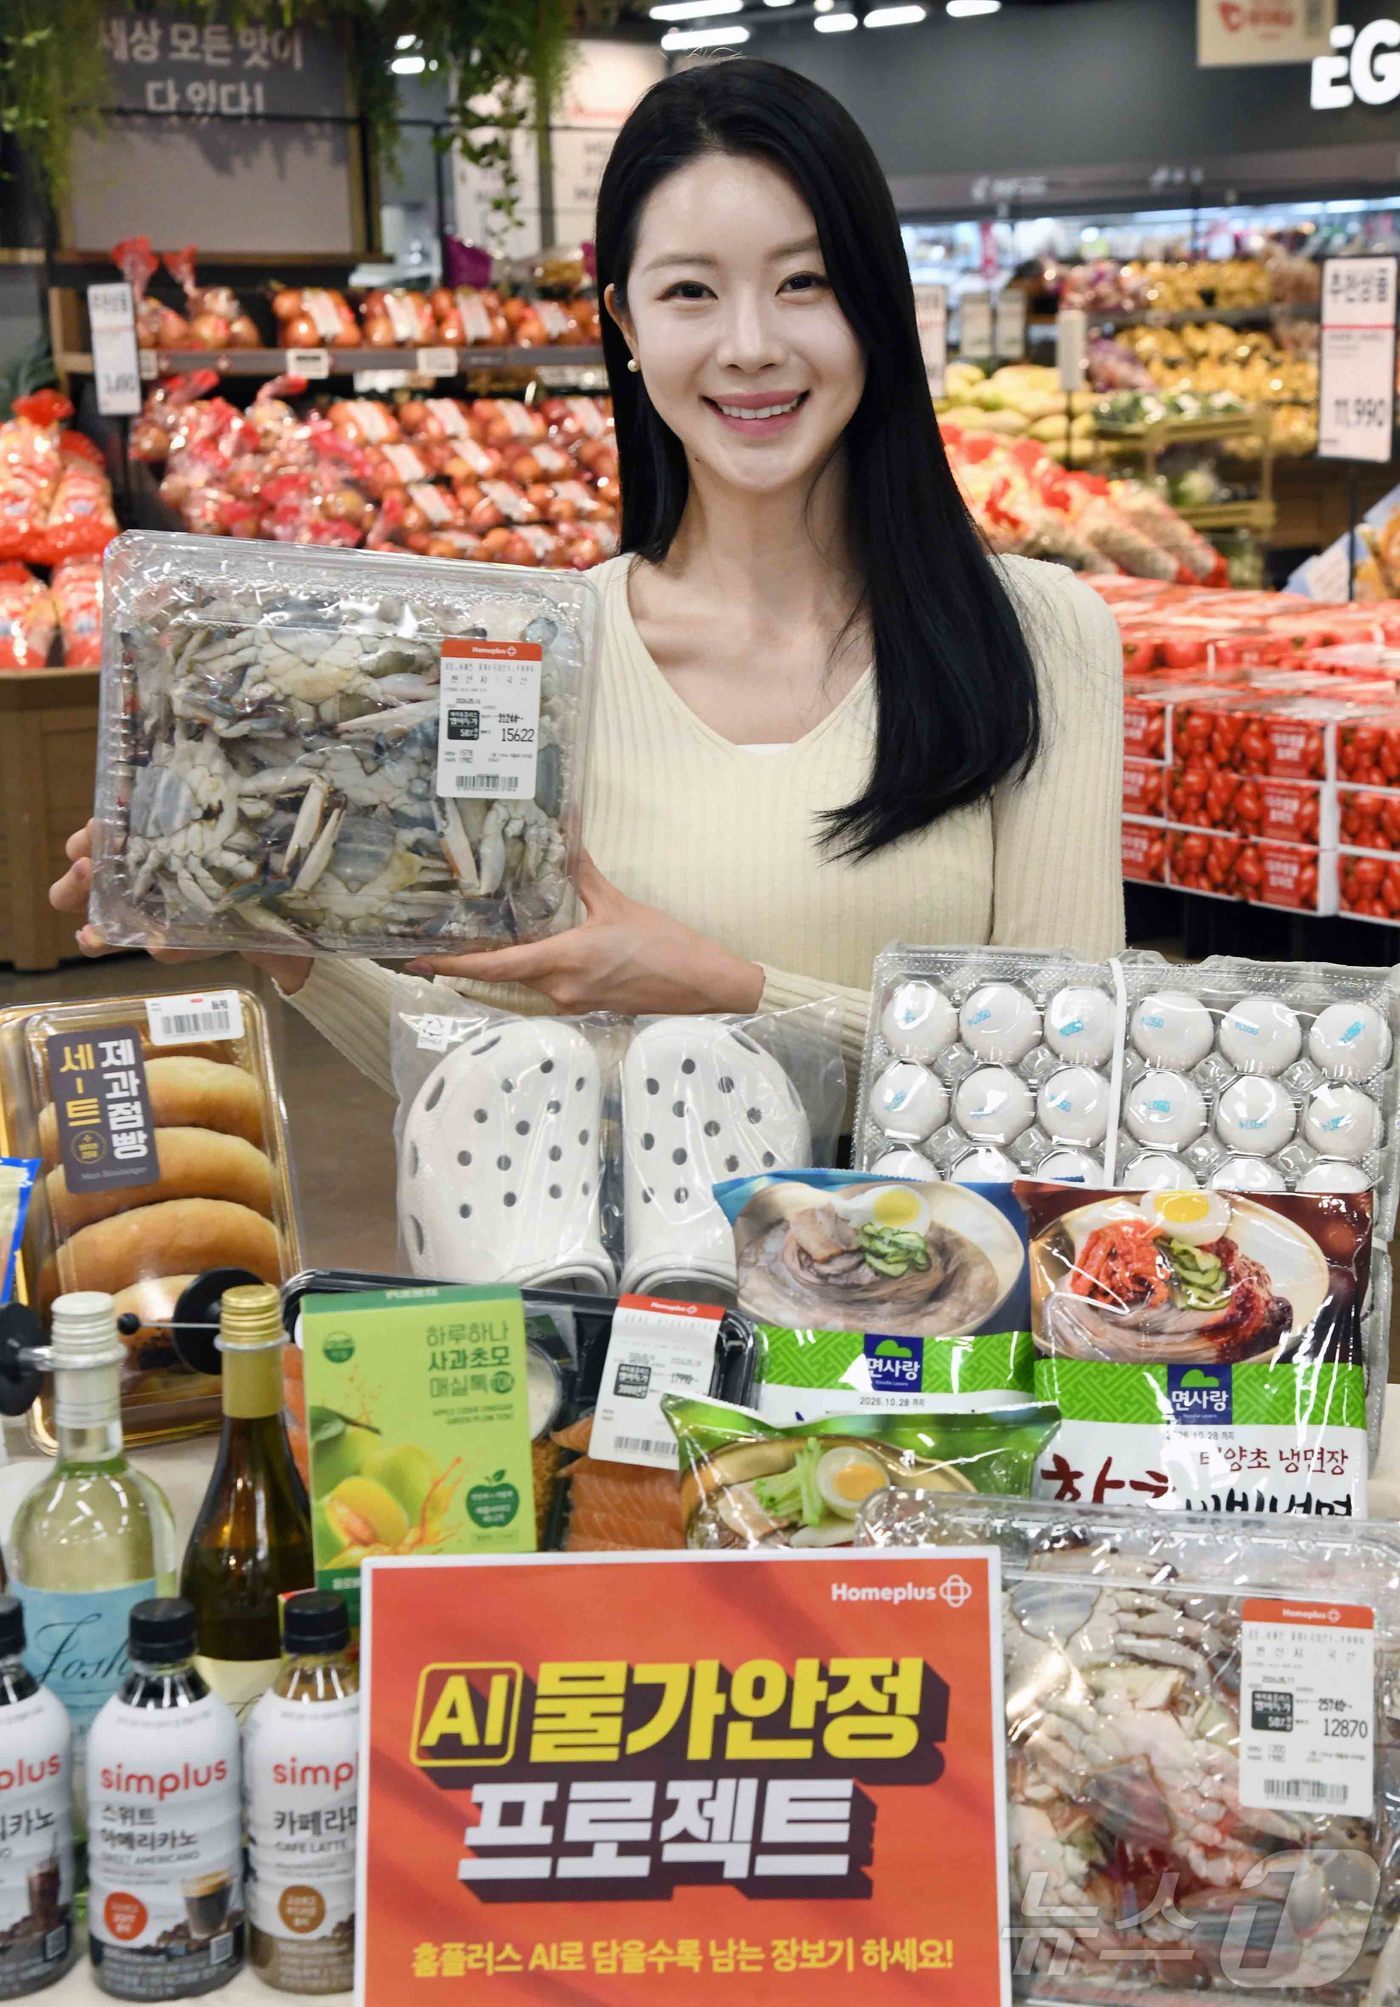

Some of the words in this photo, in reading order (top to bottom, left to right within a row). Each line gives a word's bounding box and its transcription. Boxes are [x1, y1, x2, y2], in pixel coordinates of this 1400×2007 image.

[168, 23, 232, 66] 모든
[145, 78, 180, 113] 다
[472, 646, 506, 656] Homeplus
[501, 727, 535, 743] 15622
[98, 1038, 149, 1160] 제과점빵
[651, 1301, 686, 1314] Homeplus
[426, 1321, 509, 1348] 하루하나
[428, 1346, 511, 1371] 사과초모
[866, 1358, 921, 1381] 면사랑
[1171, 1390, 1230, 1412] 면사랑
[1279, 1447, 1350, 1476] 냉면장
[831, 1582, 937, 1606] Homeplus
[1282, 1608, 1327, 1621] Homeplus
[419, 1674, 510, 1748] AI
[529, 1656, 925, 1763] 물가안정
[1323, 1718, 1369, 1739] 12870
[101, 1759, 228, 1802] simplus
[102, 1805, 157, 1827] 스위트
[101, 1828, 198, 1852] 아메리카노
[457, 1777, 855, 1881] 프로젝트
[412, 1940, 524, 1978] 홈플러스
[528, 1940, 587, 1972] AI로
[591, 1937, 703, 1975] 담을수록
[708, 1937, 766, 1974] 남는
[770, 1937, 854, 1973] 장보기
[860, 1937, 954, 1974] 하세요!
